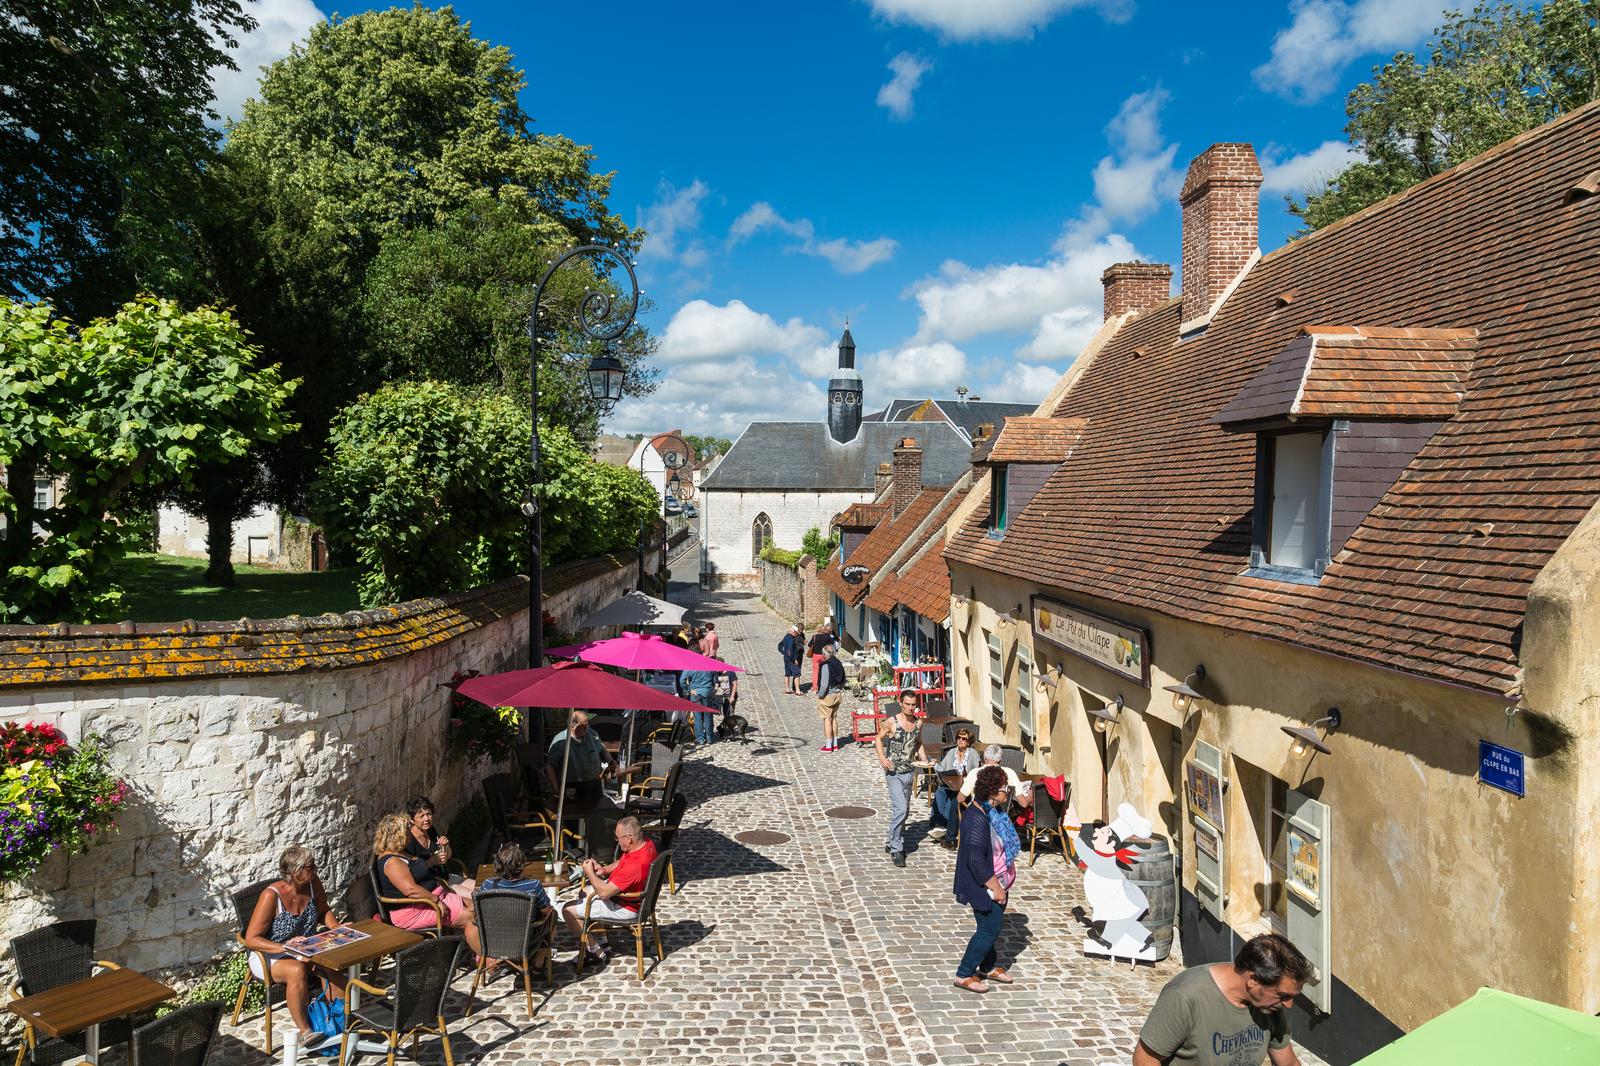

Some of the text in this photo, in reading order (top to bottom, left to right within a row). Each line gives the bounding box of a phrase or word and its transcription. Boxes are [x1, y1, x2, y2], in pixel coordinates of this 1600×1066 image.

[1056, 611, 1065, 631] Le
[1066, 614, 1077, 635] Pot
[1078, 620, 1087, 639] du
[1088, 622, 1110, 651] Clape
[1483, 758, 1520, 777] CLAPE EN BAS
